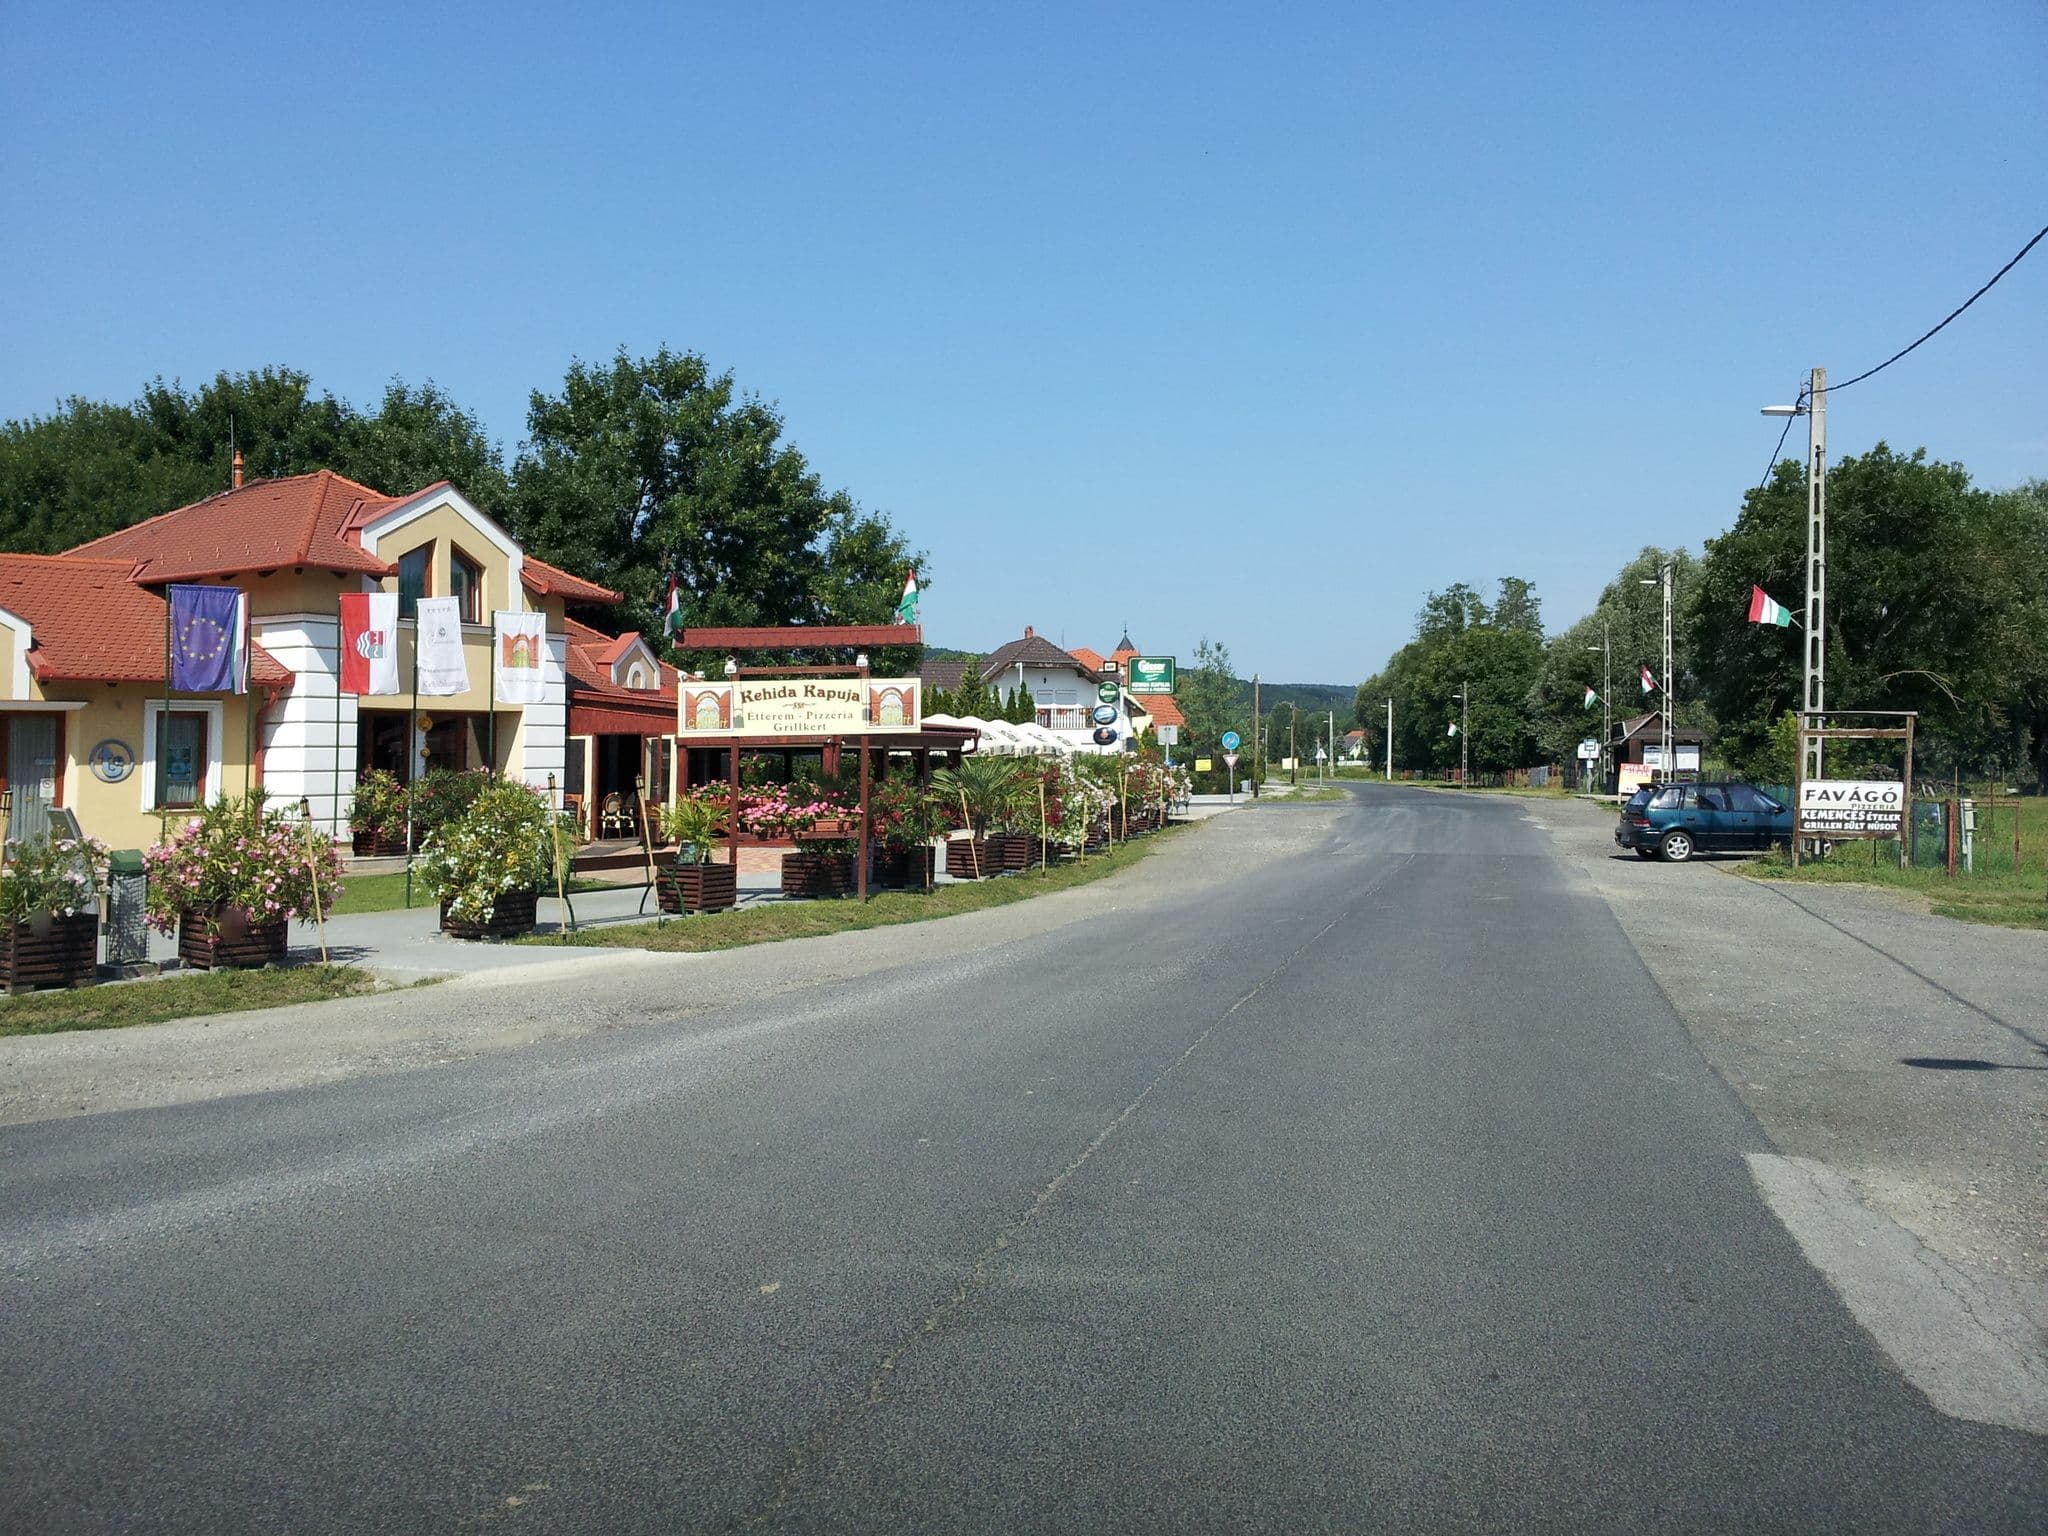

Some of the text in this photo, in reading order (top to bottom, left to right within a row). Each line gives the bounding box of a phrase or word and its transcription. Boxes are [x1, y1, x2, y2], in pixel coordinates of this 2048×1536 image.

[741, 685, 860, 704] Kehida Kapuja
[773, 722, 827, 732] Grillkert
[1805, 786, 1898, 803] FAVÁGÓ
[1801, 809, 1902, 821] KEMENCES ÉTELEK
[1803, 821, 1842, 830] GRILLEN
[1843, 820, 1866, 830] SÜLT
